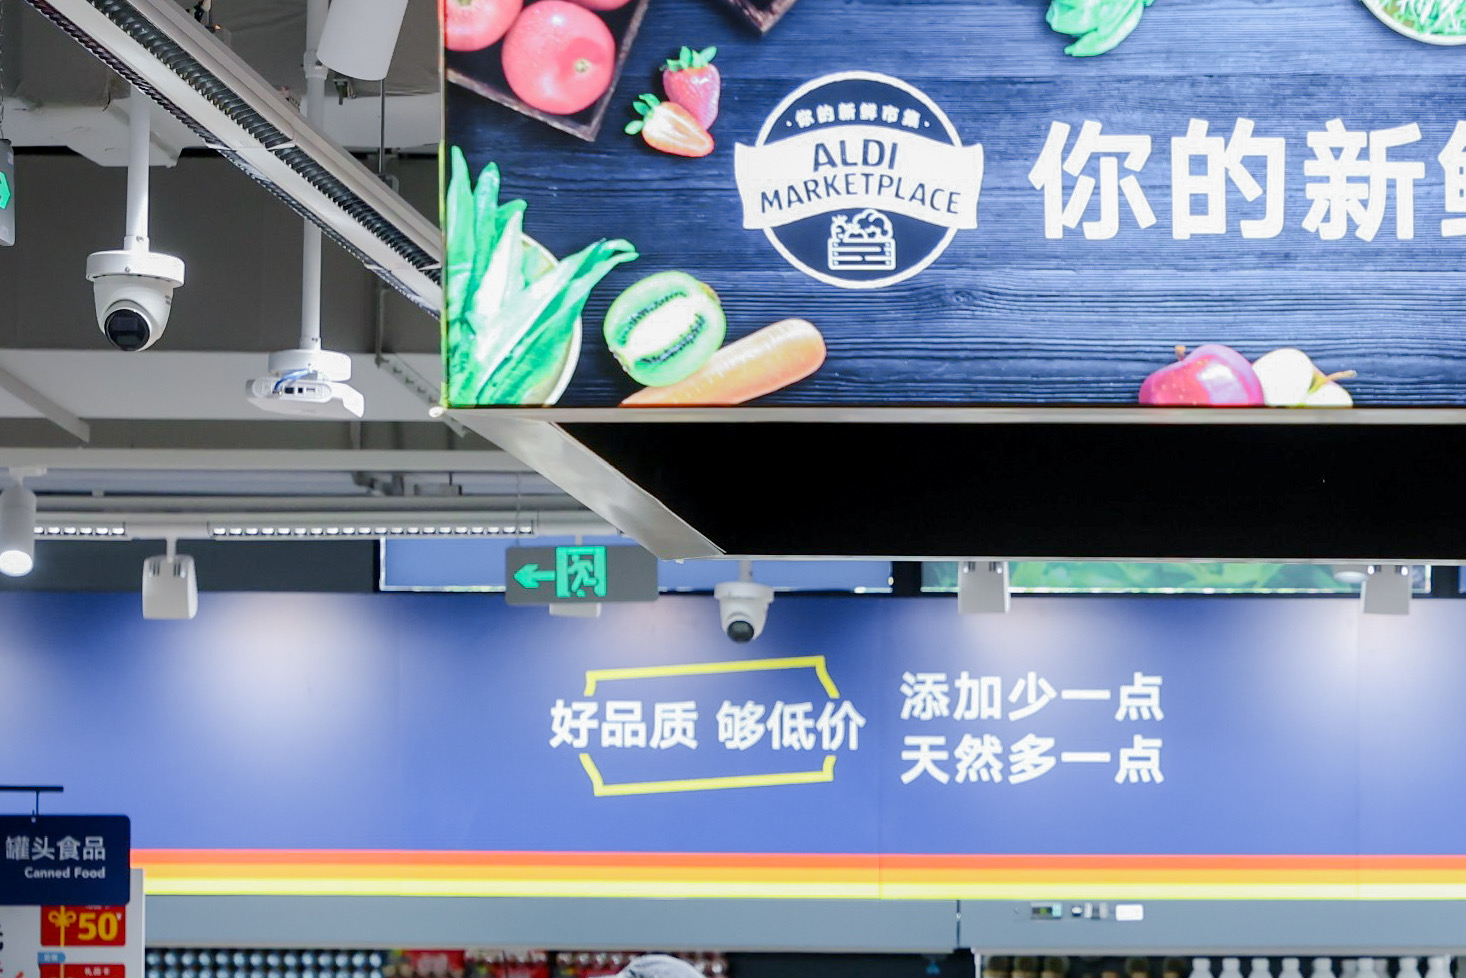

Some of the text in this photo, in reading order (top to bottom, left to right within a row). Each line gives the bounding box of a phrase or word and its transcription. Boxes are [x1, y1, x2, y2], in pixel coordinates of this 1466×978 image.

[812, 138, 899, 172] ALDI
[760, 172, 962, 214] MARKETPLACE
[900, 671, 1165, 722] 添加少一点
[549, 700, 866, 751] 好品质 够低价
[900, 734, 1165, 785] 天然多一点
[5, 835, 106, 861] 罐头食品
[24, 866, 106, 879] Canned Food
[77, 912, 119, 942] 50
